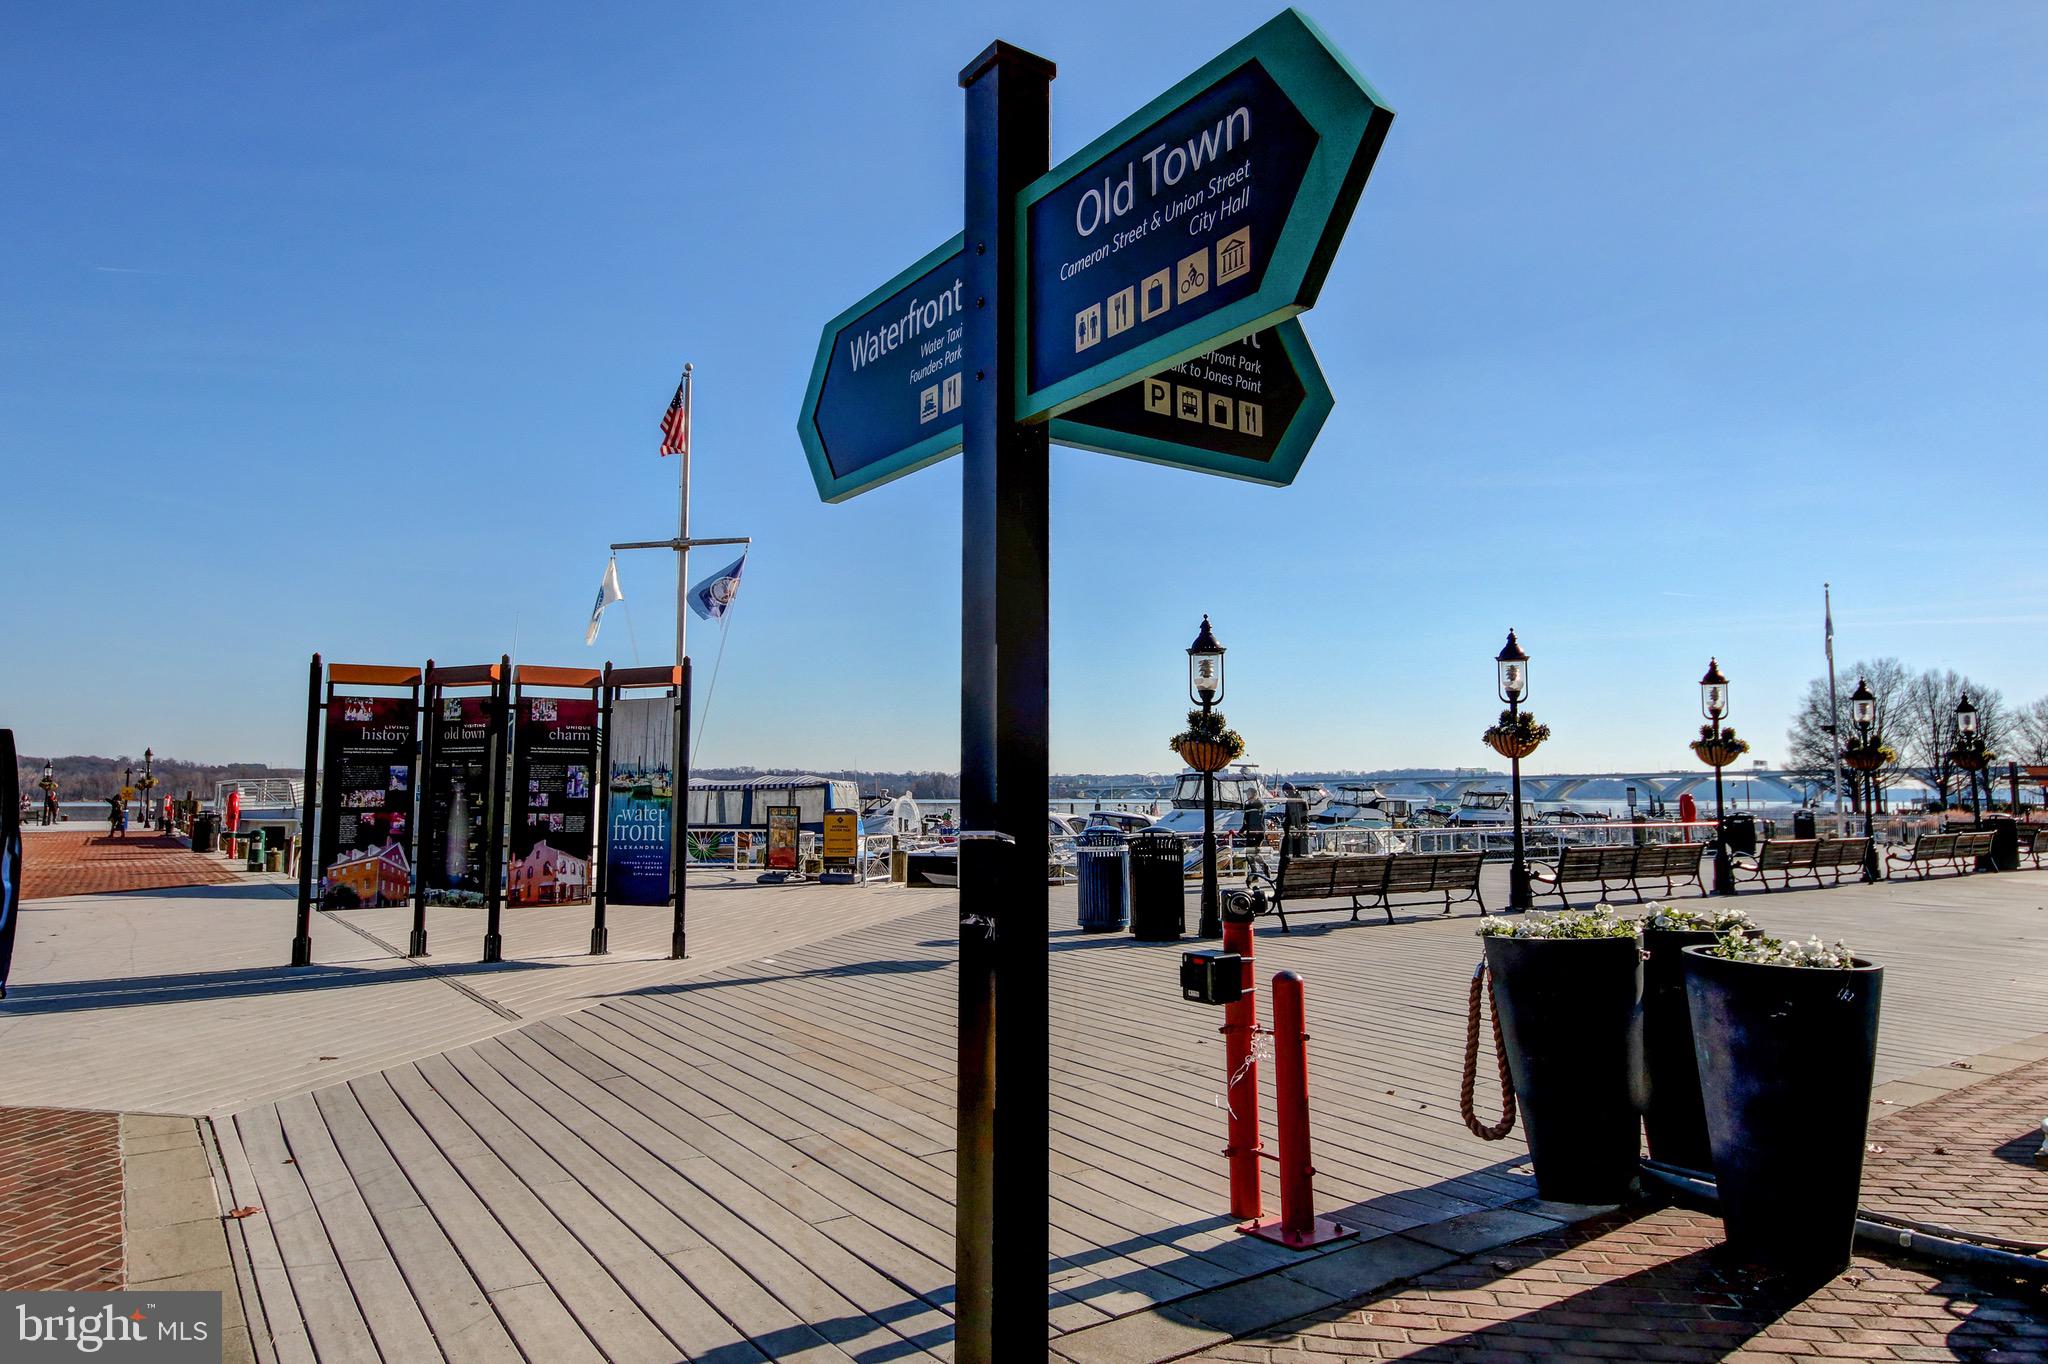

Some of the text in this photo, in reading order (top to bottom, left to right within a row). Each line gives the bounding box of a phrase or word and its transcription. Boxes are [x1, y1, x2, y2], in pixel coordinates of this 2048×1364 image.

[1076, 105, 1250, 237] Old Town
[1060, 159, 1251, 281] Cameron Street & Union Street
[1189, 186, 1250, 236] City Hall
[850, 277, 963, 373] Waterfront
[920, 322, 963, 359] Water Taxi
[909, 346, 963, 385] Founders Park
[1190, 362, 1201, 378] to
[1203, 366, 1233, 387] Jones
[1235, 373, 1262, 395] Point
[1238, 355, 1262, 375] Park
[361, 726, 410, 745] history
[444, 726, 485, 740] old town
[549, 726, 590, 741] charm
[612, 814, 665, 841] front
[622, 805, 665, 821] water
